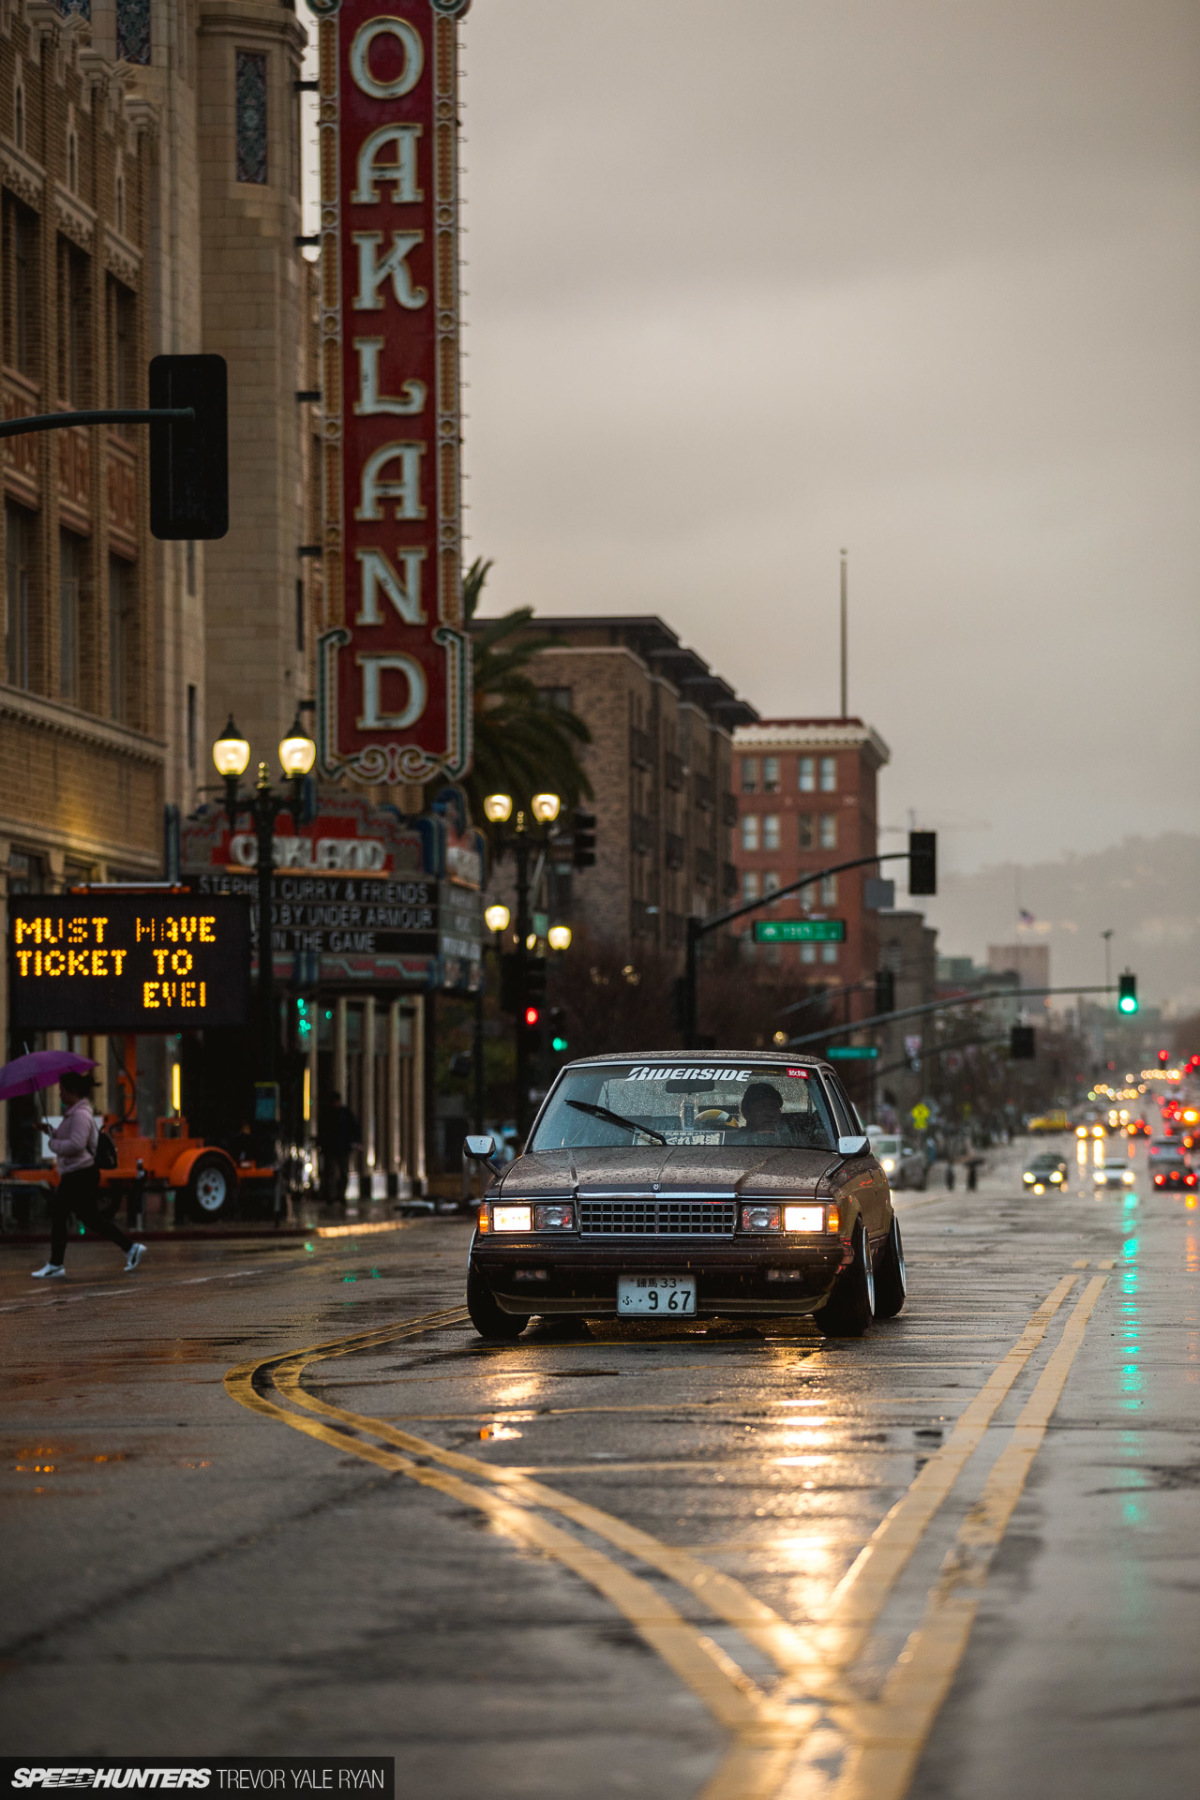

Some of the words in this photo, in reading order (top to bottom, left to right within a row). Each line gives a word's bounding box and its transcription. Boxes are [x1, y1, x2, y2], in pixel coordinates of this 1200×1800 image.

[350, 15, 429, 731] OAKLAND
[281, 880, 340, 900] CURRY
[361, 883, 428, 904] FRIENDS
[280, 905, 302, 925] BY
[307, 906, 361, 927] UNDER
[366, 908, 432, 928] ARMOUR
[15, 917, 108, 944] MUST
[136, 916, 216, 943] HAVE
[294, 932, 318, 951] THE
[330, 933, 376, 952] GAME
[16, 949, 127, 976] TICKET
[153, 949, 193, 975] TO
